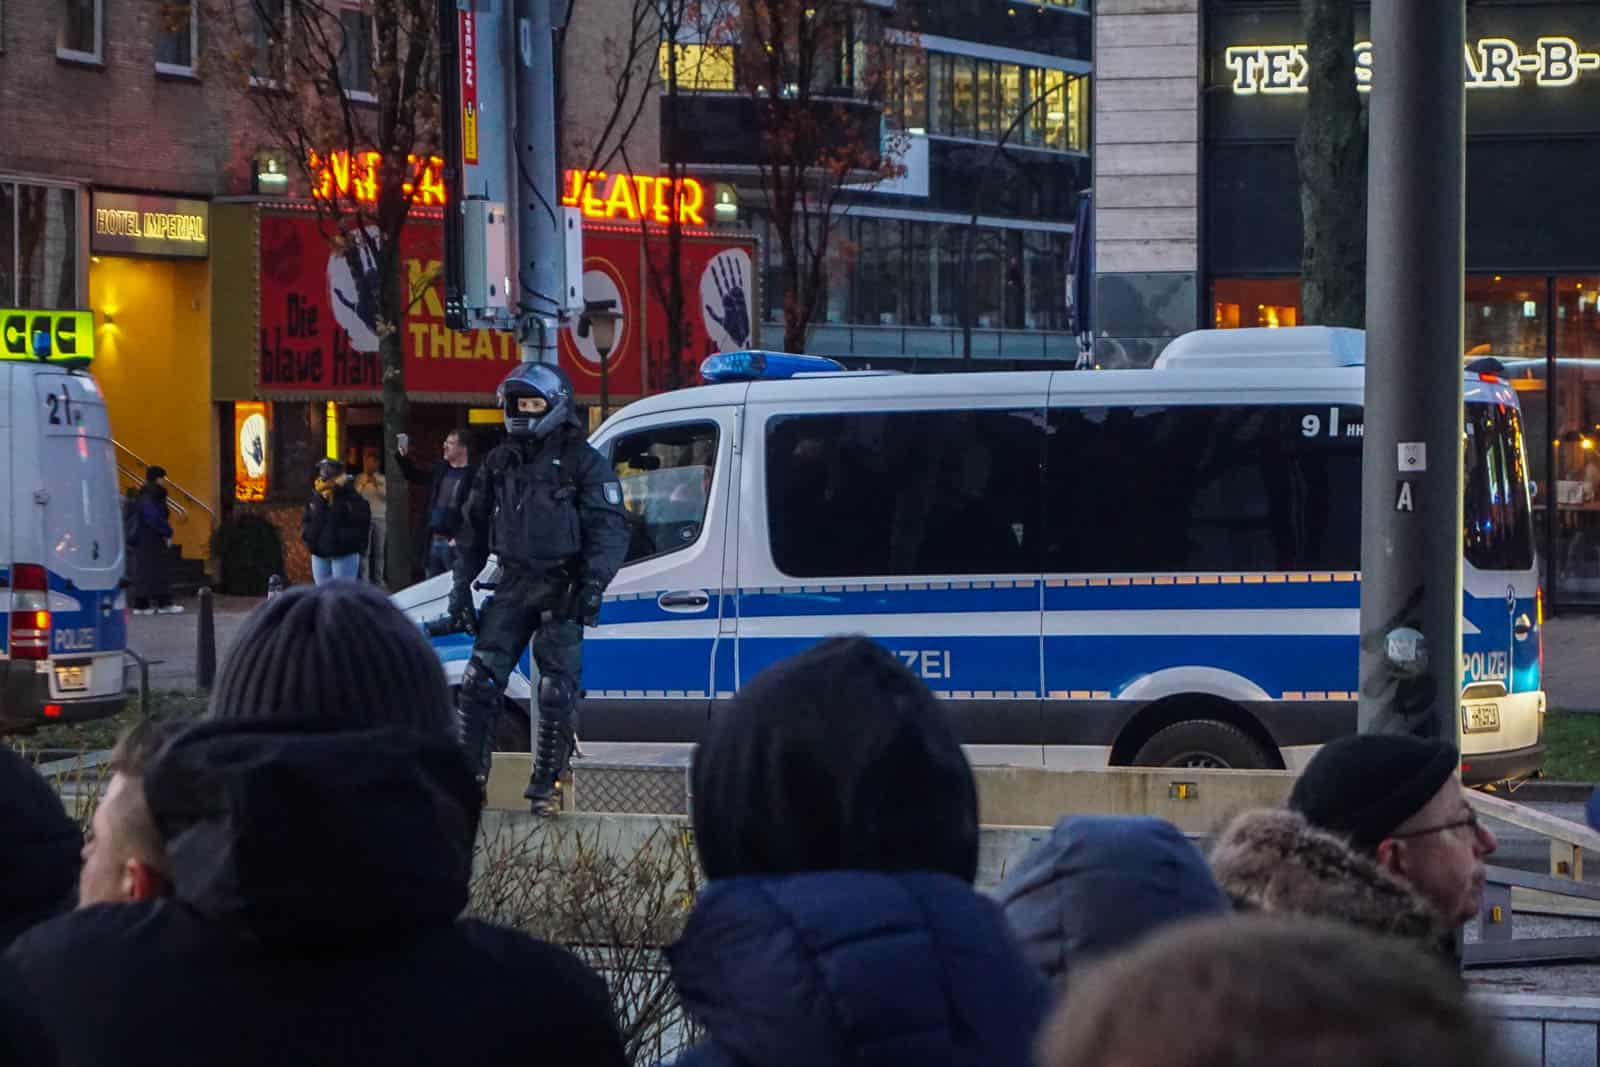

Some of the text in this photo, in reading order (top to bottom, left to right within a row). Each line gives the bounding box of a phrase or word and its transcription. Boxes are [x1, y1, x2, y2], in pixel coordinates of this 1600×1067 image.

[562, 169, 704, 225] EATER
[96, 208, 205, 242] HOTEL IMPERIAL
[286, 291, 319, 337] Die
[260, 327, 383, 386] blaue Han
[408, 322, 522, 361] THEAT
[1396, 481, 1414, 512] A
[1462, 651, 1507, 681] POLIZEI
